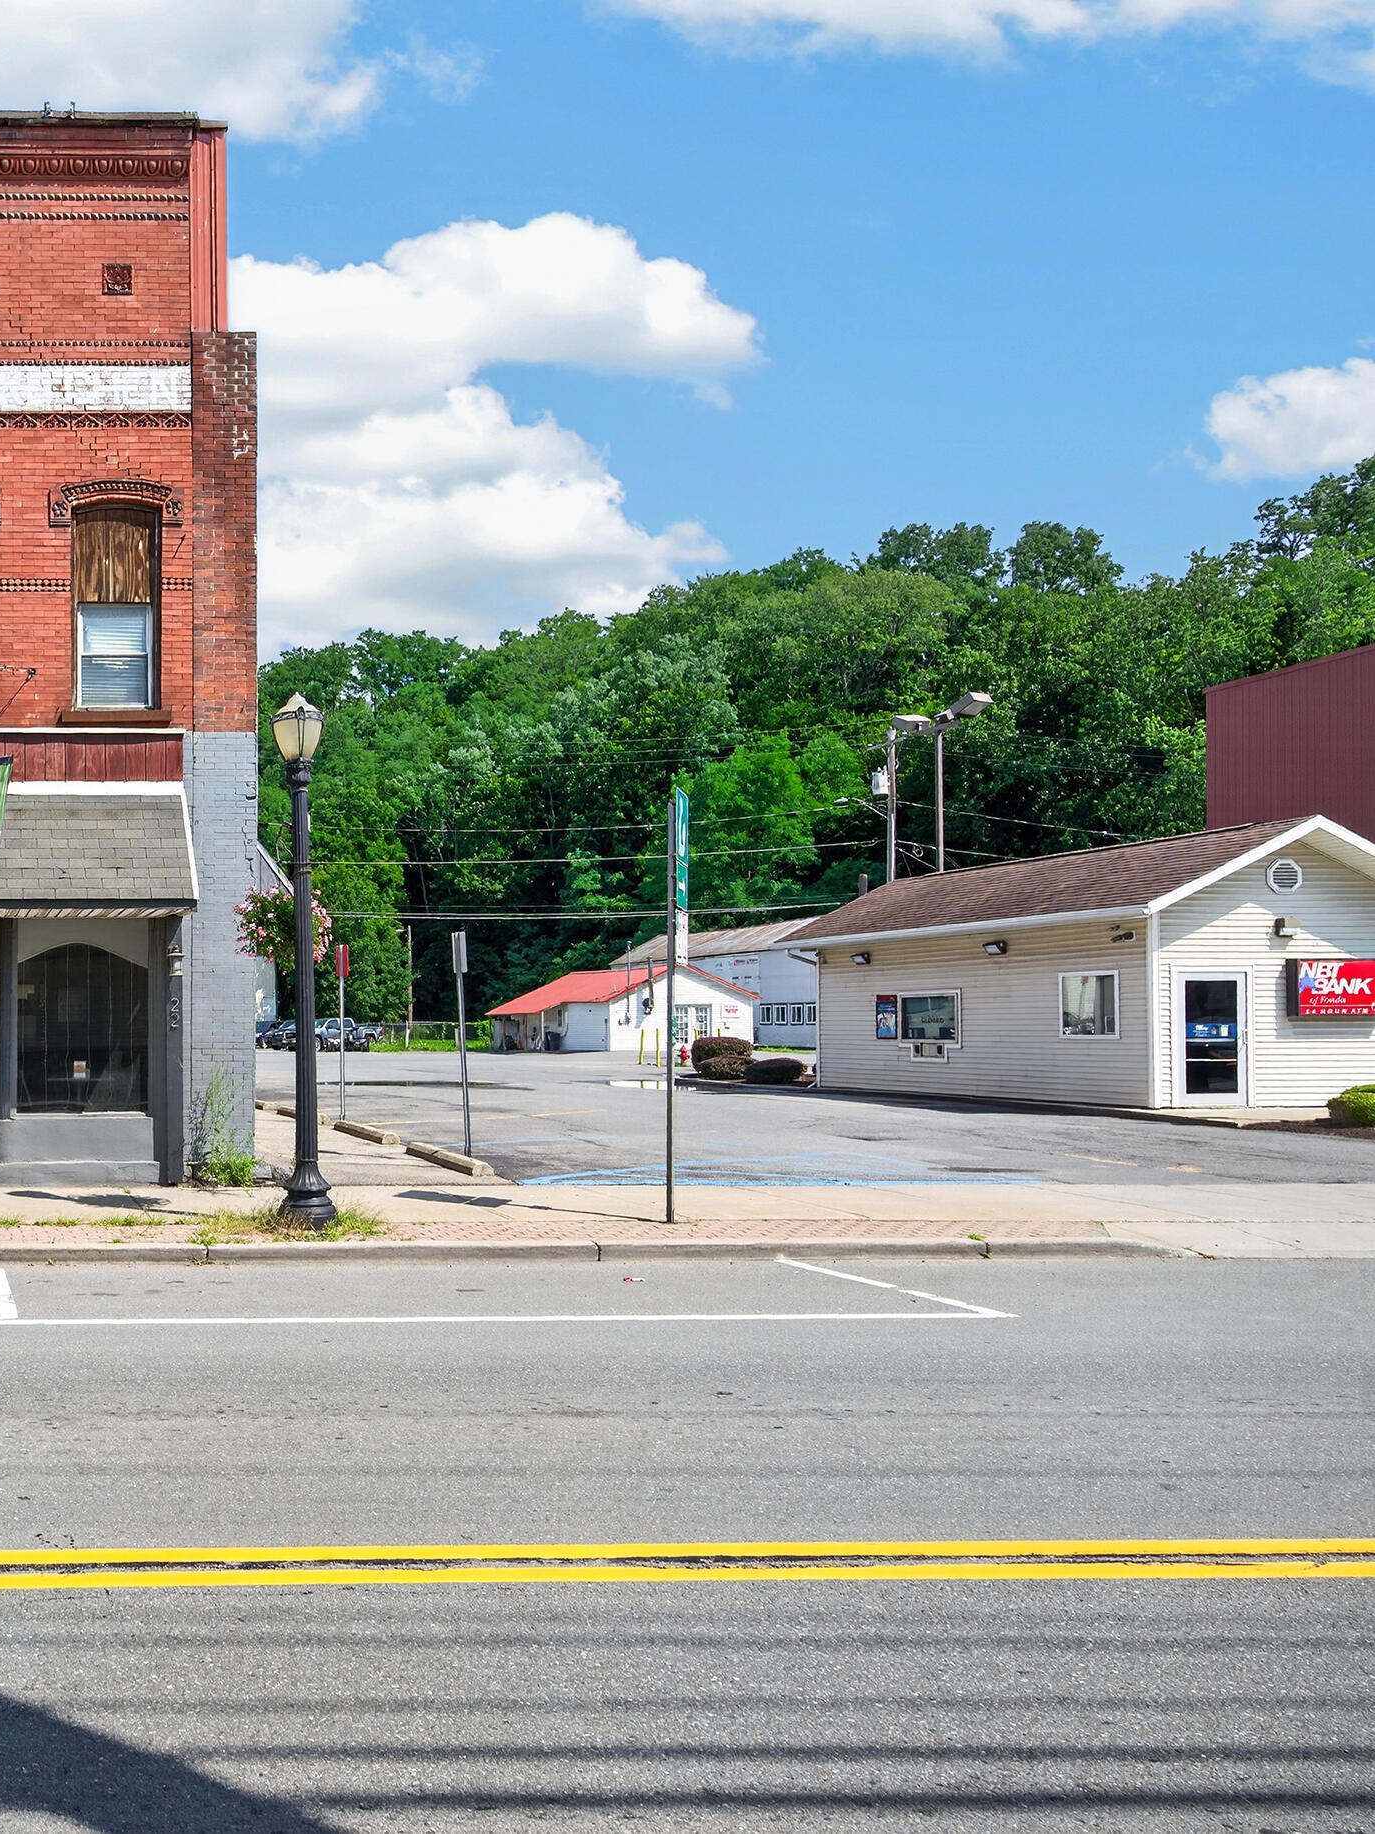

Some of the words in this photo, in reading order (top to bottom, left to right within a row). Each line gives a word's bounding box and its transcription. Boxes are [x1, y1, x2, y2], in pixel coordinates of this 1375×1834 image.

[1299, 961, 1345, 979] NBT
[1311, 977, 1373, 995] BANK
[1320, 995, 1347, 1004] Fonda
[170, 997, 180, 1028] 22
